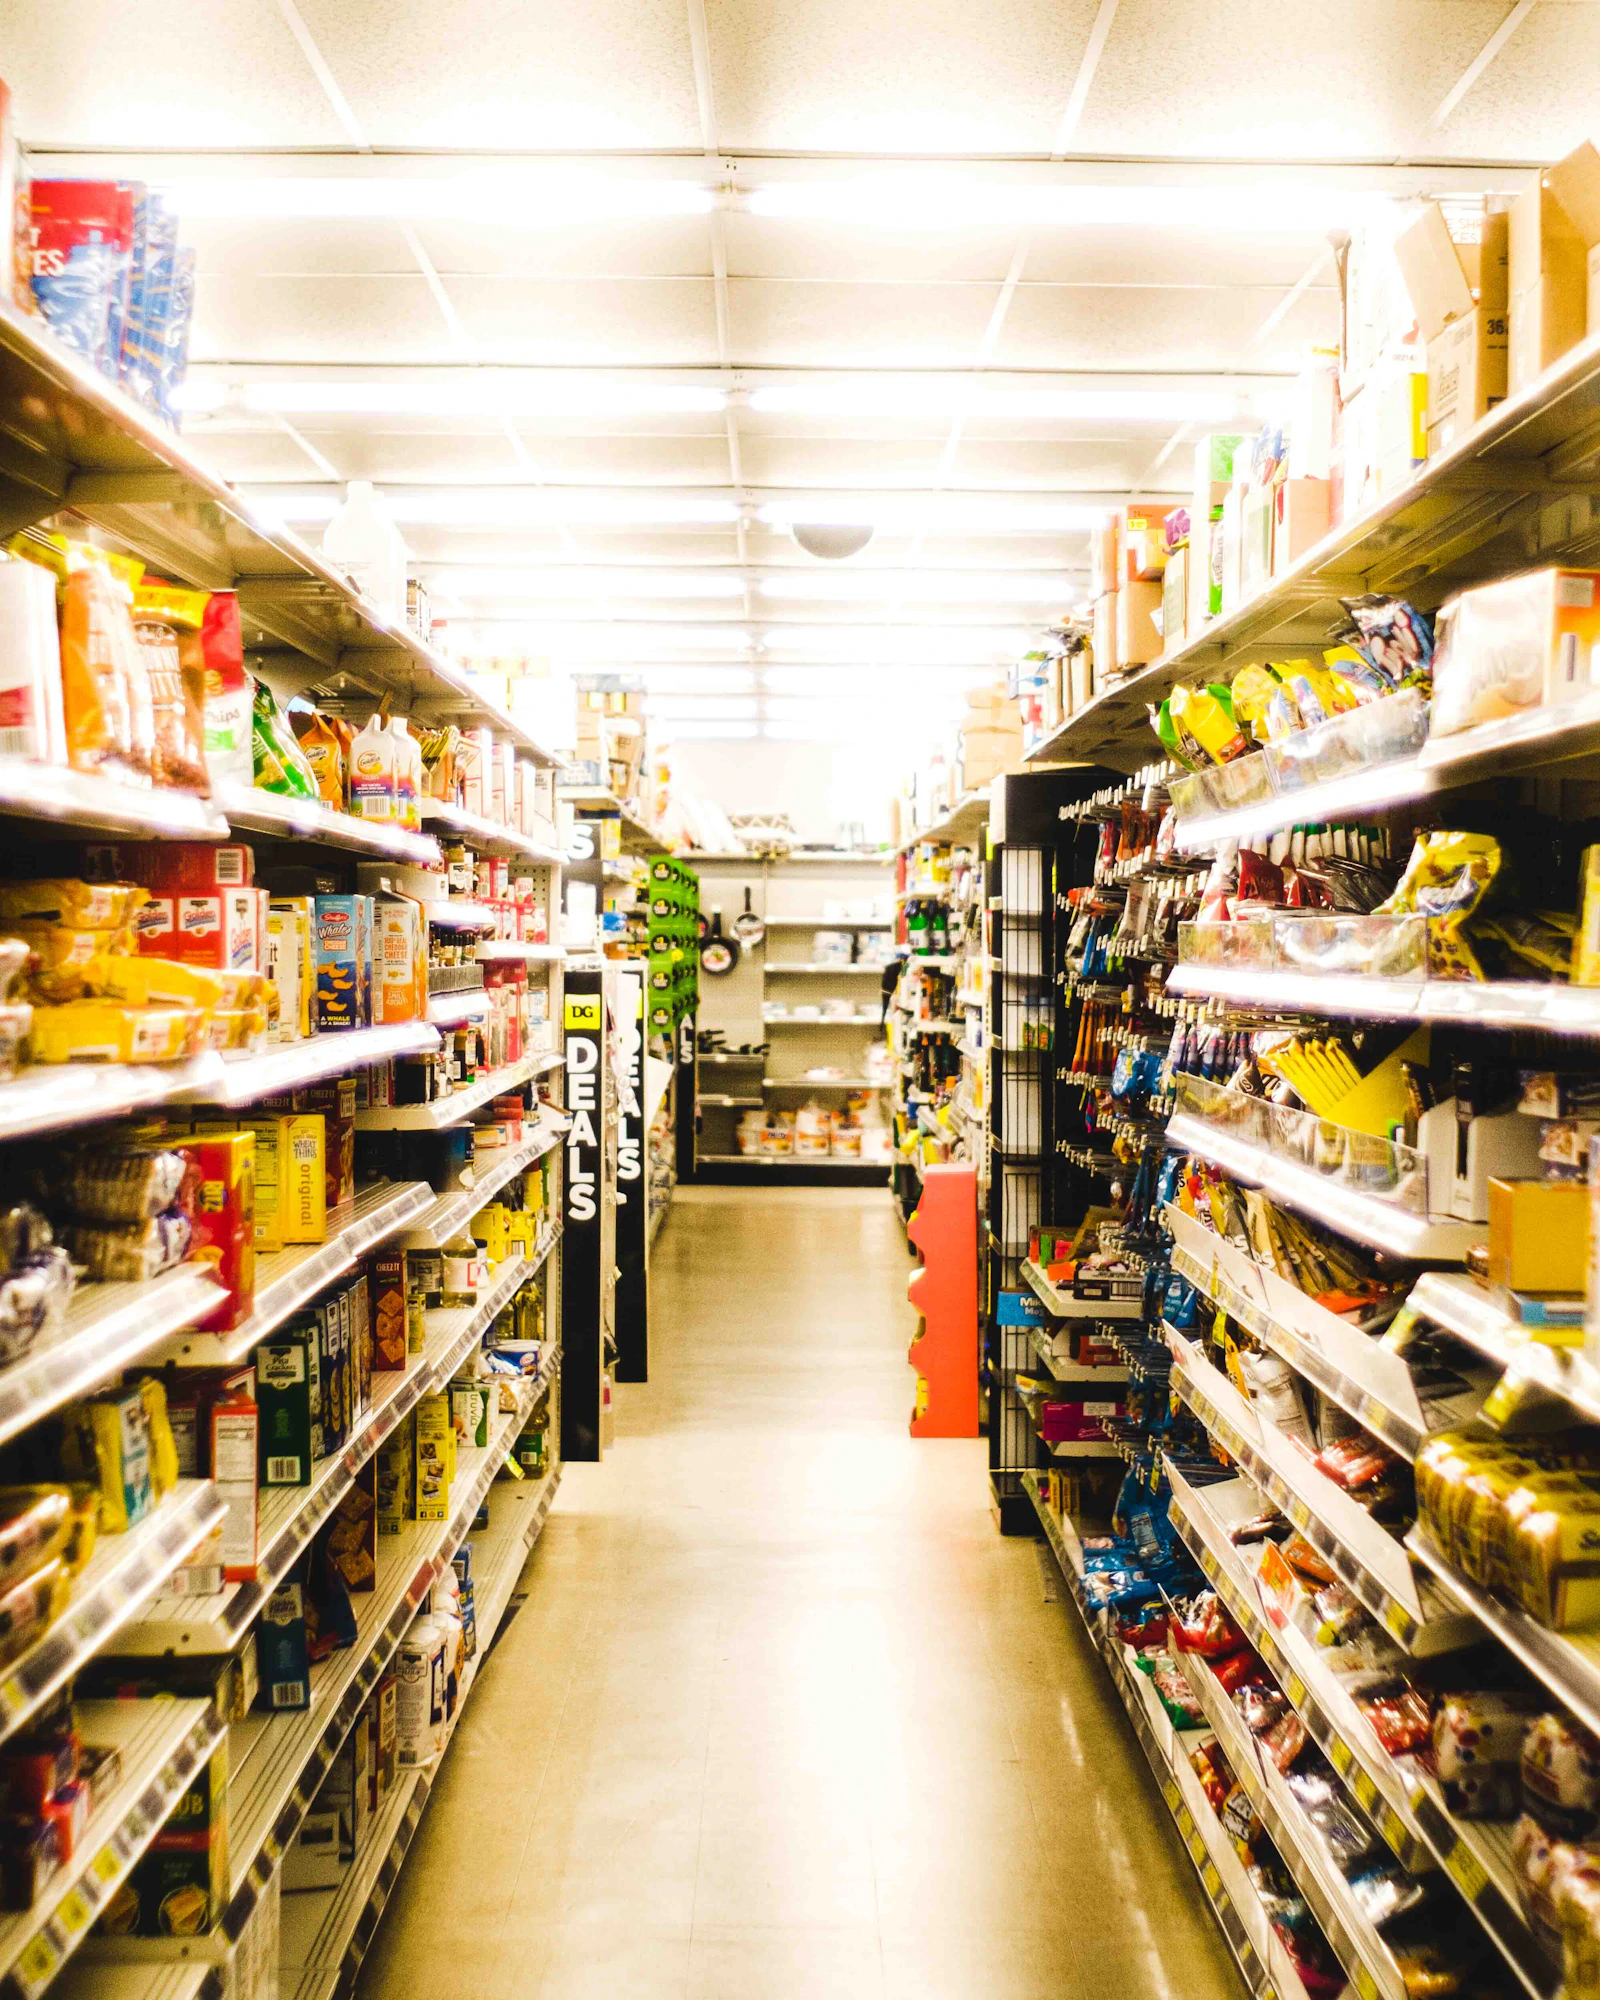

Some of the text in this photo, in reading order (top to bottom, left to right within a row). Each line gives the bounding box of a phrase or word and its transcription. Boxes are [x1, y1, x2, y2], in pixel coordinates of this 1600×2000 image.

[31, 250, 65, 277] ES
[318, 922, 352, 938] Whales
[384, 951, 408, 959] CHEESE
[571, 1005, 594, 1018] DG
[566, 1036, 599, 1221] DEALS
[293, 1139, 317, 1149] WHEAT
[294, 1148, 318, 1159] THINS
[298, 1163, 314, 1226] original
